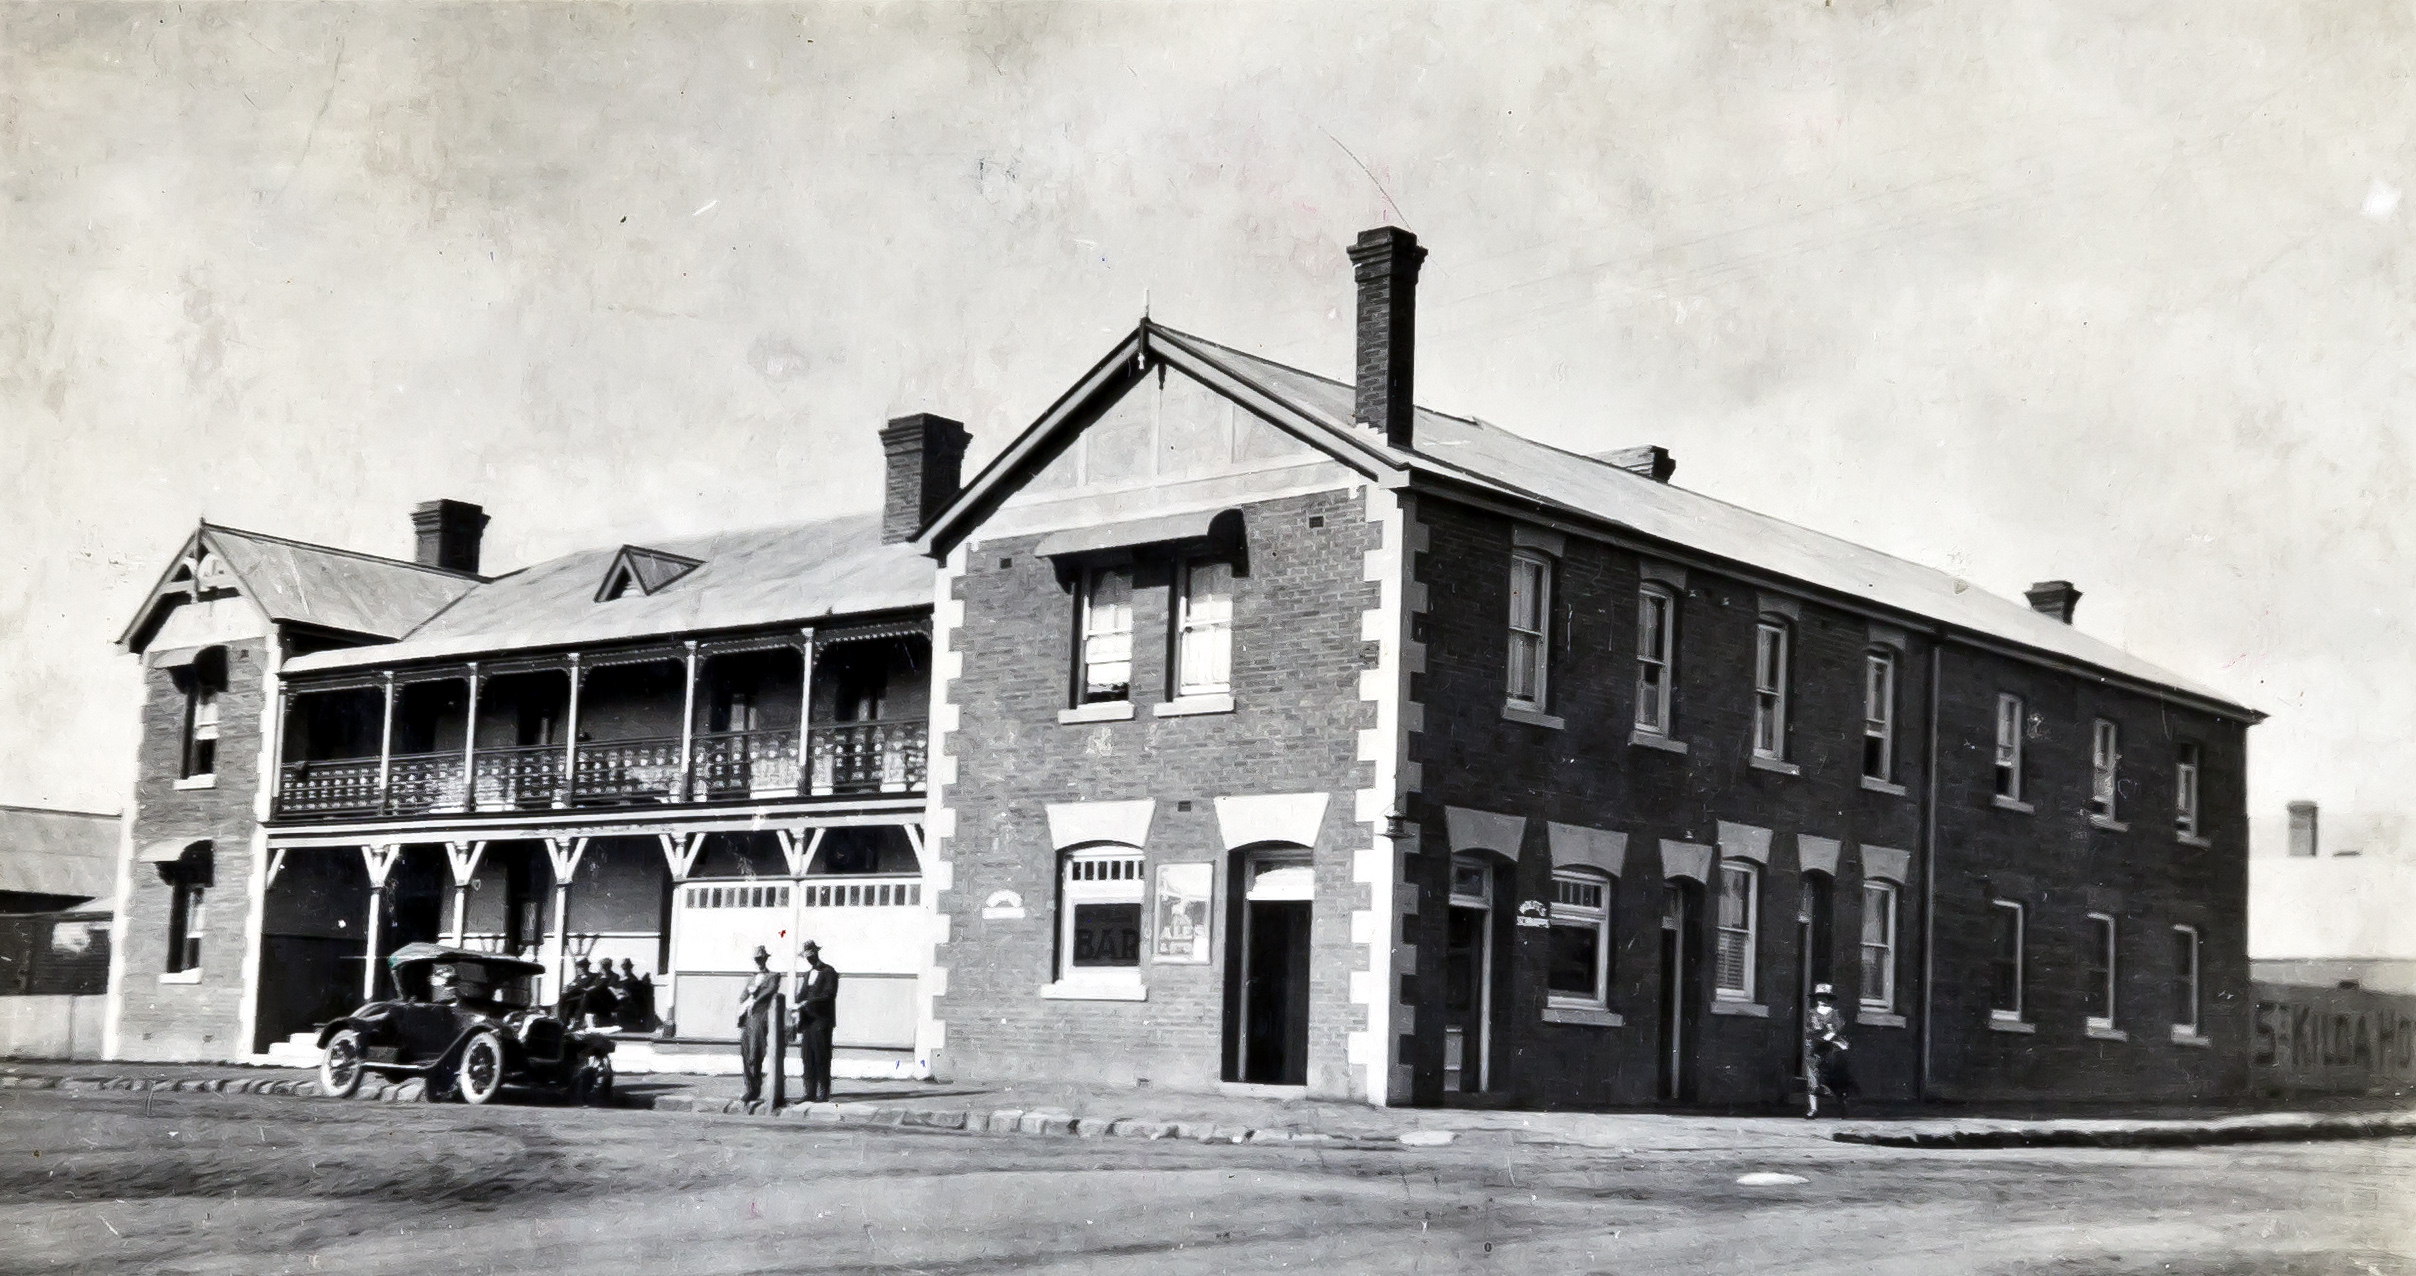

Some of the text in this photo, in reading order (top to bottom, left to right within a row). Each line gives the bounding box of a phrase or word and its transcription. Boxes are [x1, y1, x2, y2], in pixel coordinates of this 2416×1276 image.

[1076, 928, 1138, 960] BAR
[2291, 1005, 2372, 1068] KILDA
[2377, 1008, 2416, 1072] HO
